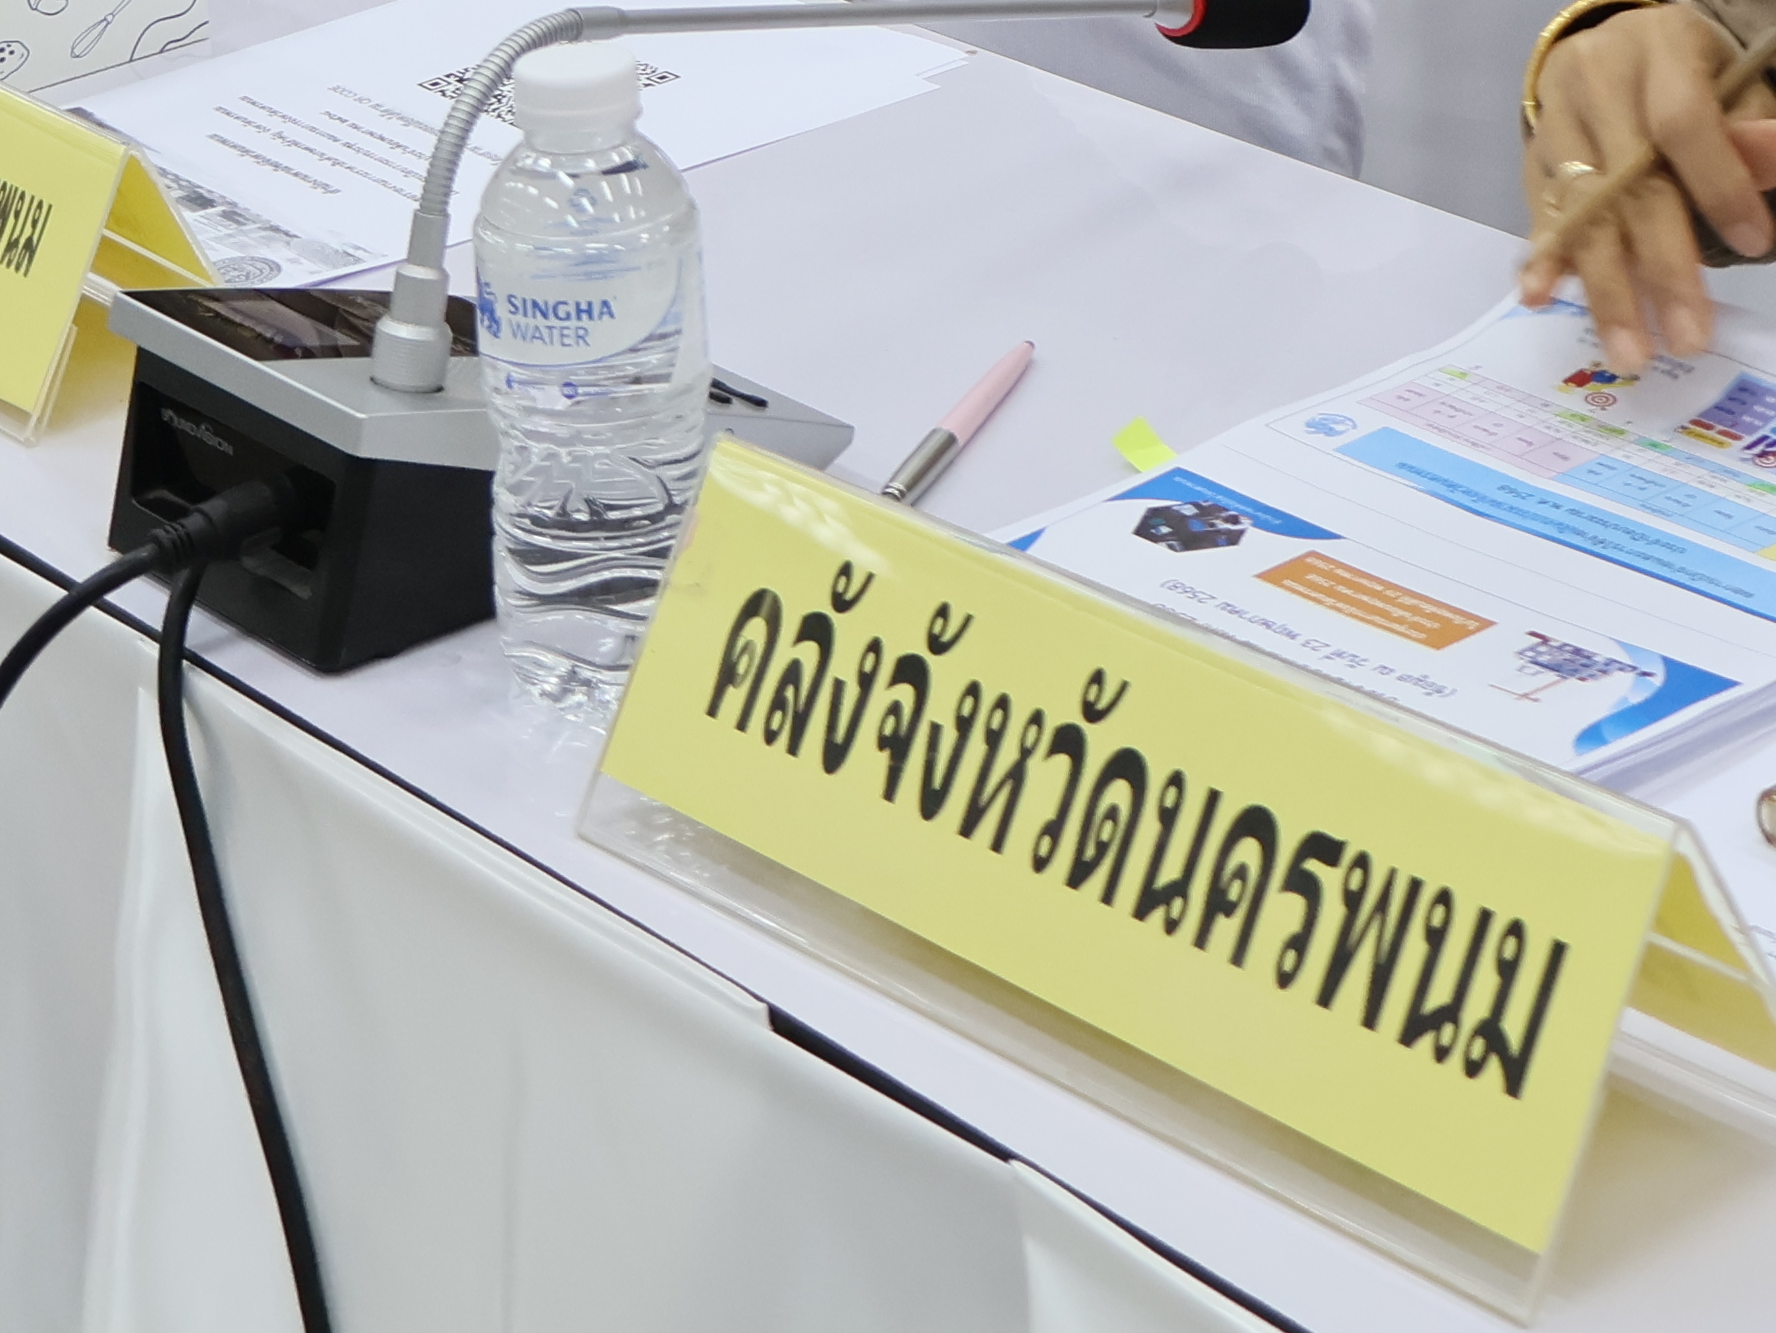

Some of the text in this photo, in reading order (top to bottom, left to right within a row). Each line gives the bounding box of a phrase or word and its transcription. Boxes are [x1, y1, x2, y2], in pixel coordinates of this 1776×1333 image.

[507, 294, 616, 322] SINGHA
[509, 318, 591, 347] WATER
[1158, 577, 1217, 605] 2568)
[1301, 638, 1331, 653] 23
[706, 559, 1570, 1102] คลังจังหวัดนครพนม
